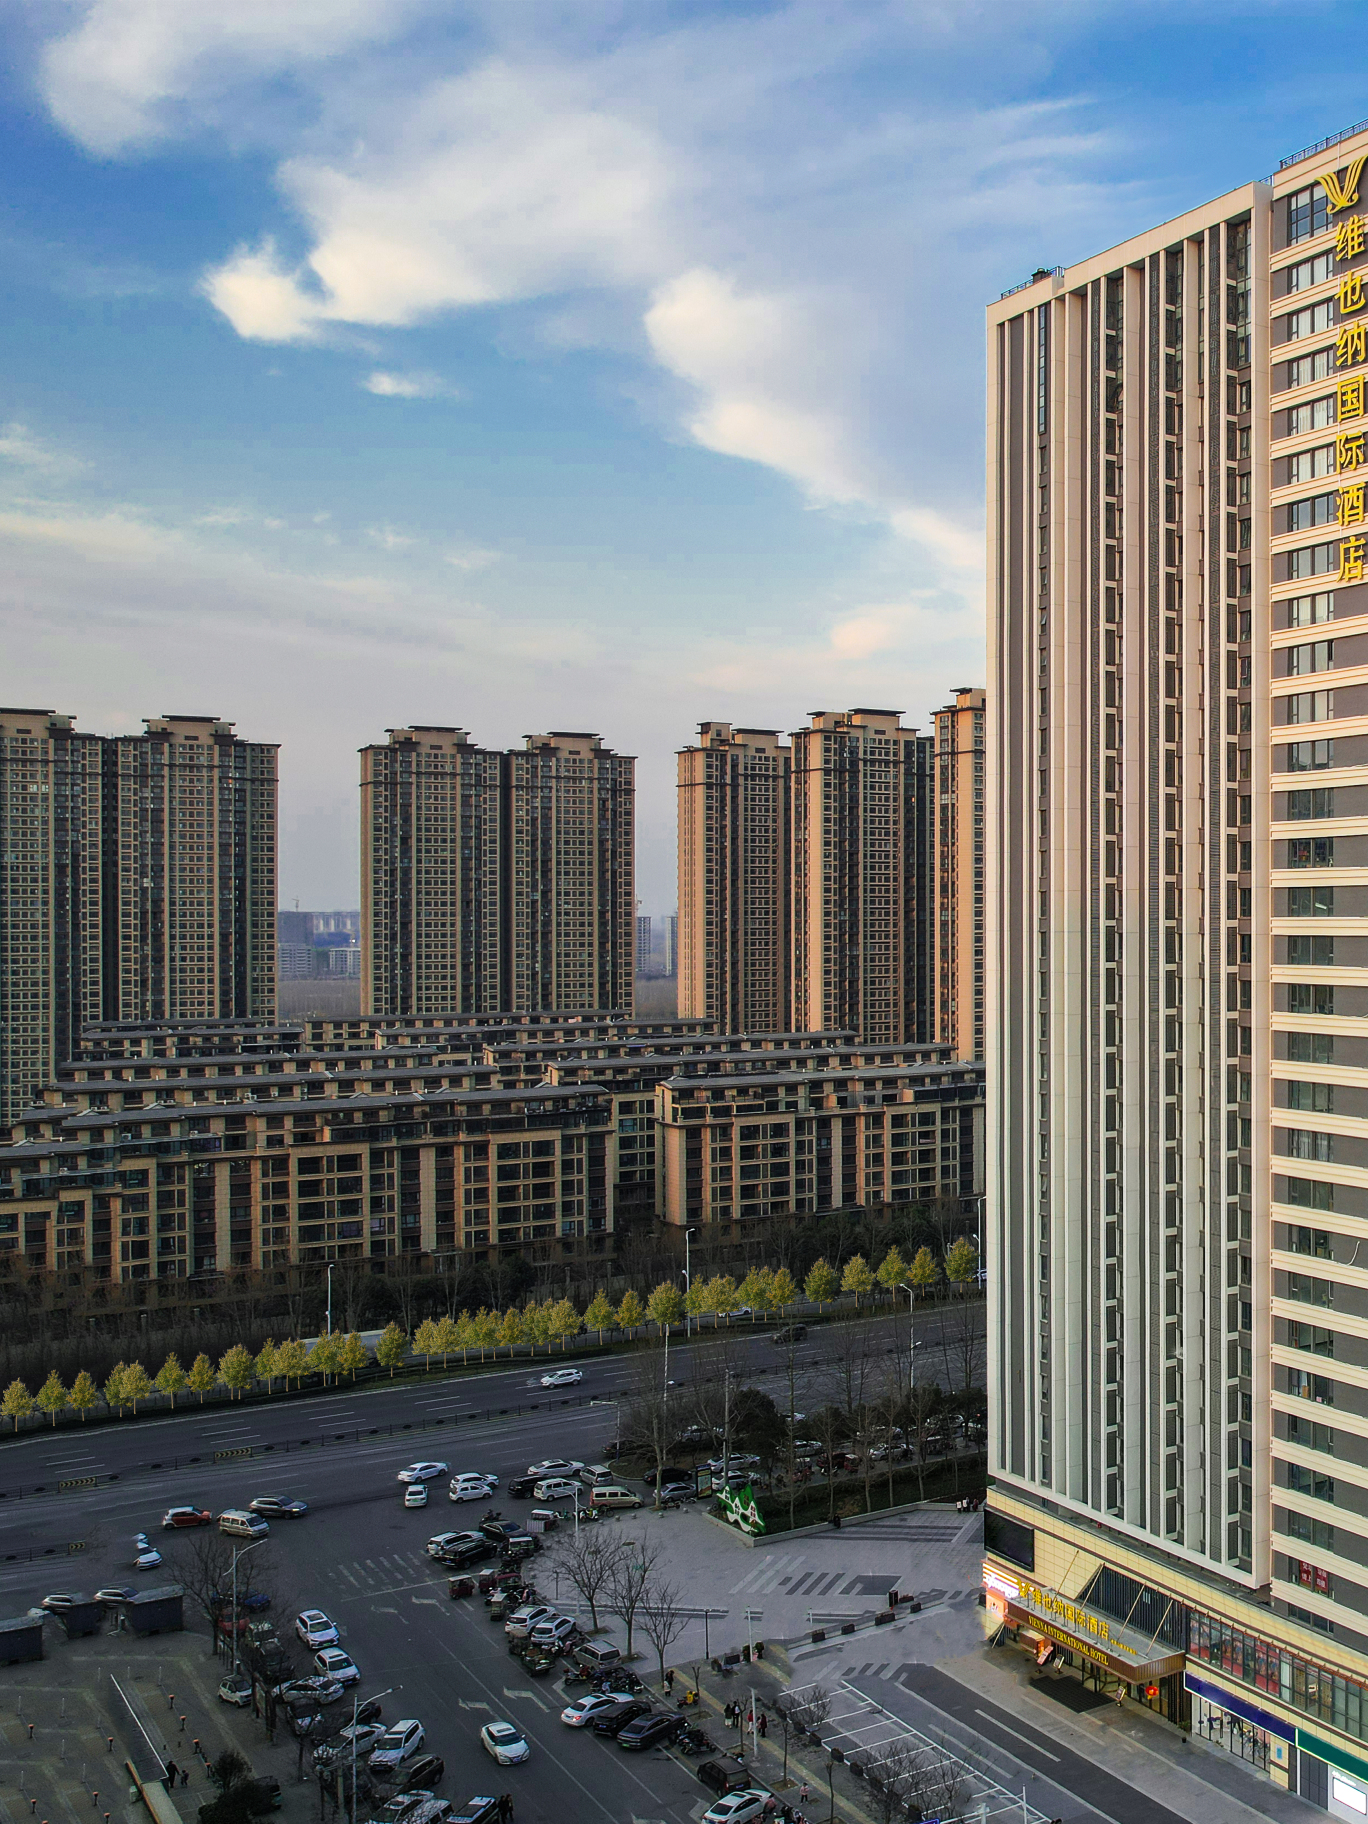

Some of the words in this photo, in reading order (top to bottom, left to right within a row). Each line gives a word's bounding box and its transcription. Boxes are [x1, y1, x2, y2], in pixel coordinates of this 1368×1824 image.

[1334, 214, 1367, 584] 维也纳国际酒店
[1028, 1615, 1048, 1634] VIENNA
[1047, 1625, 1090, 1656] INTERNATIONAL
[1090, 1647, 1109, 1666] HOTEL
[1032, 1588, 1110, 1641] 维也纳国际酒店
